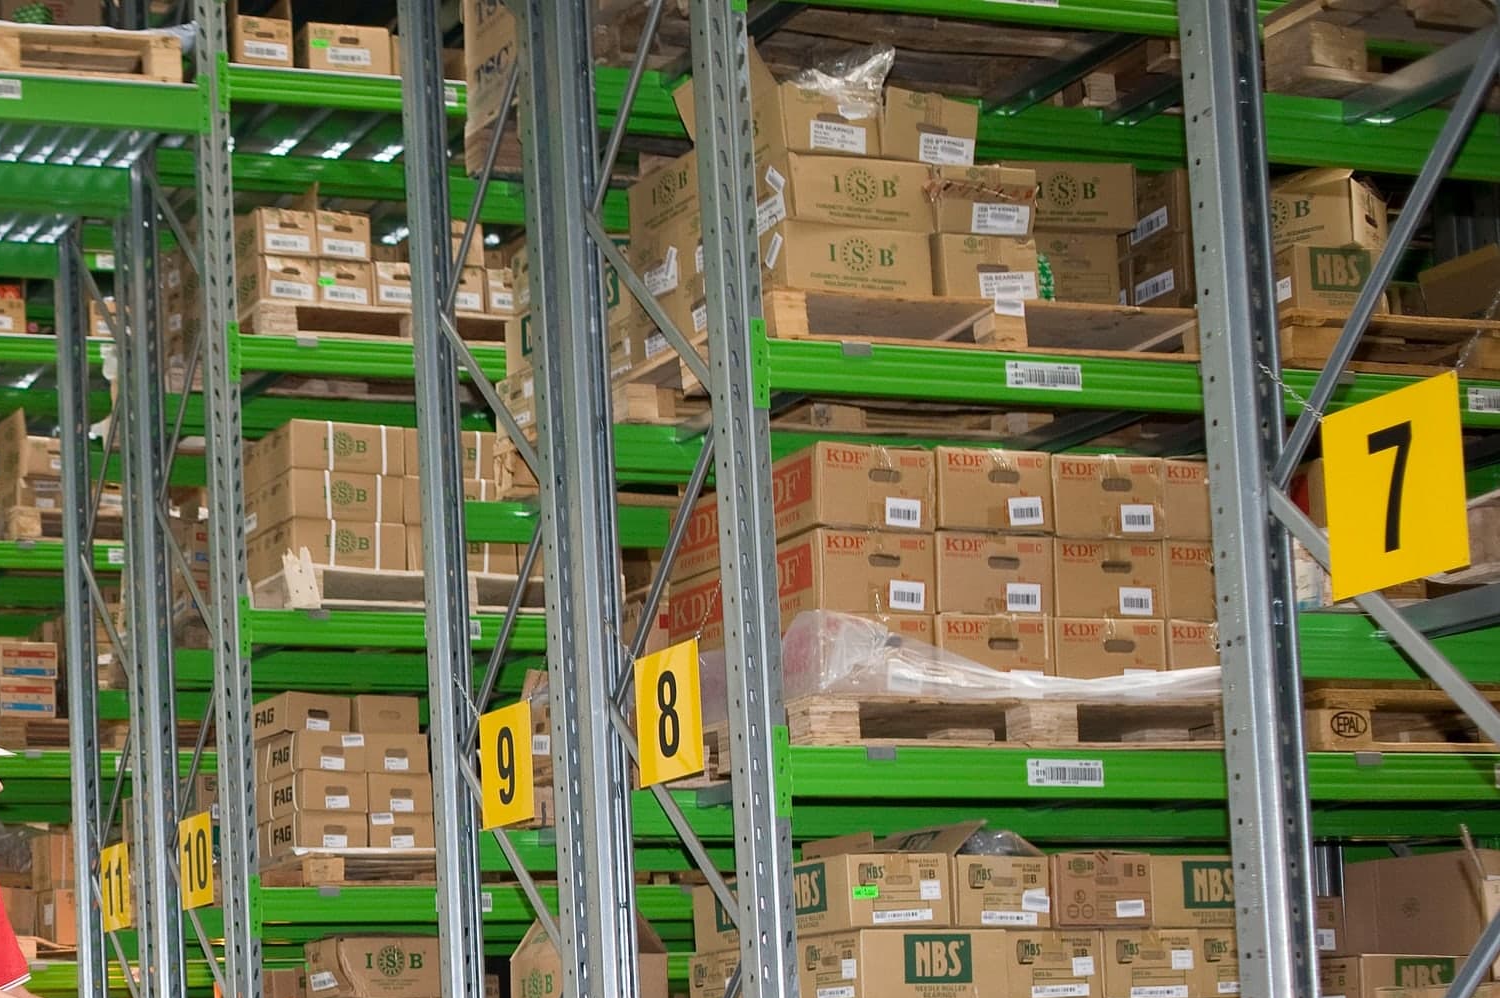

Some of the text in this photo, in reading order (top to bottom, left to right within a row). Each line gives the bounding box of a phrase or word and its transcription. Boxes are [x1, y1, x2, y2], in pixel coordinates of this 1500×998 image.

[833, 172, 898, 201] ISB
[829, 241, 895, 269] ISB
[1317, 253, 1362, 287] NBS
[827, 448, 865, 465] KDF
[947, 452, 985, 467] KDF
[1060, 461, 1099, 476] KDF
[1167, 465, 1200, 480] KDF
[1367, 420, 1413, 553] 7
[826, 535, 866, 550] KDF
[945, 538, 985, 552] KDF
[1062, 543, 1100, 557] KDF
[1171, 547, 1205, 561] KDF
[947, 620, 985, 634] KDF
[1063, 623, 1101, 637] KDF
[1171, 626, 1206, 640] KDF
[255, 708, 275, 729] FAG
[657, 670, 680, 758] 8
[1336, 715, 1361, 734] EPAL
[272, 747, 290, 768] FAG
[497, 726, 516, 805] 9
[274, 786, 293, 807] FAG
[273, 825, 292, 846] FAG
[183, 827, 208, 893] 10
[104, 857, 124, 917] 11
[365, 949, 423, 973] ISB
[915, 941, 962, 978] NBS
